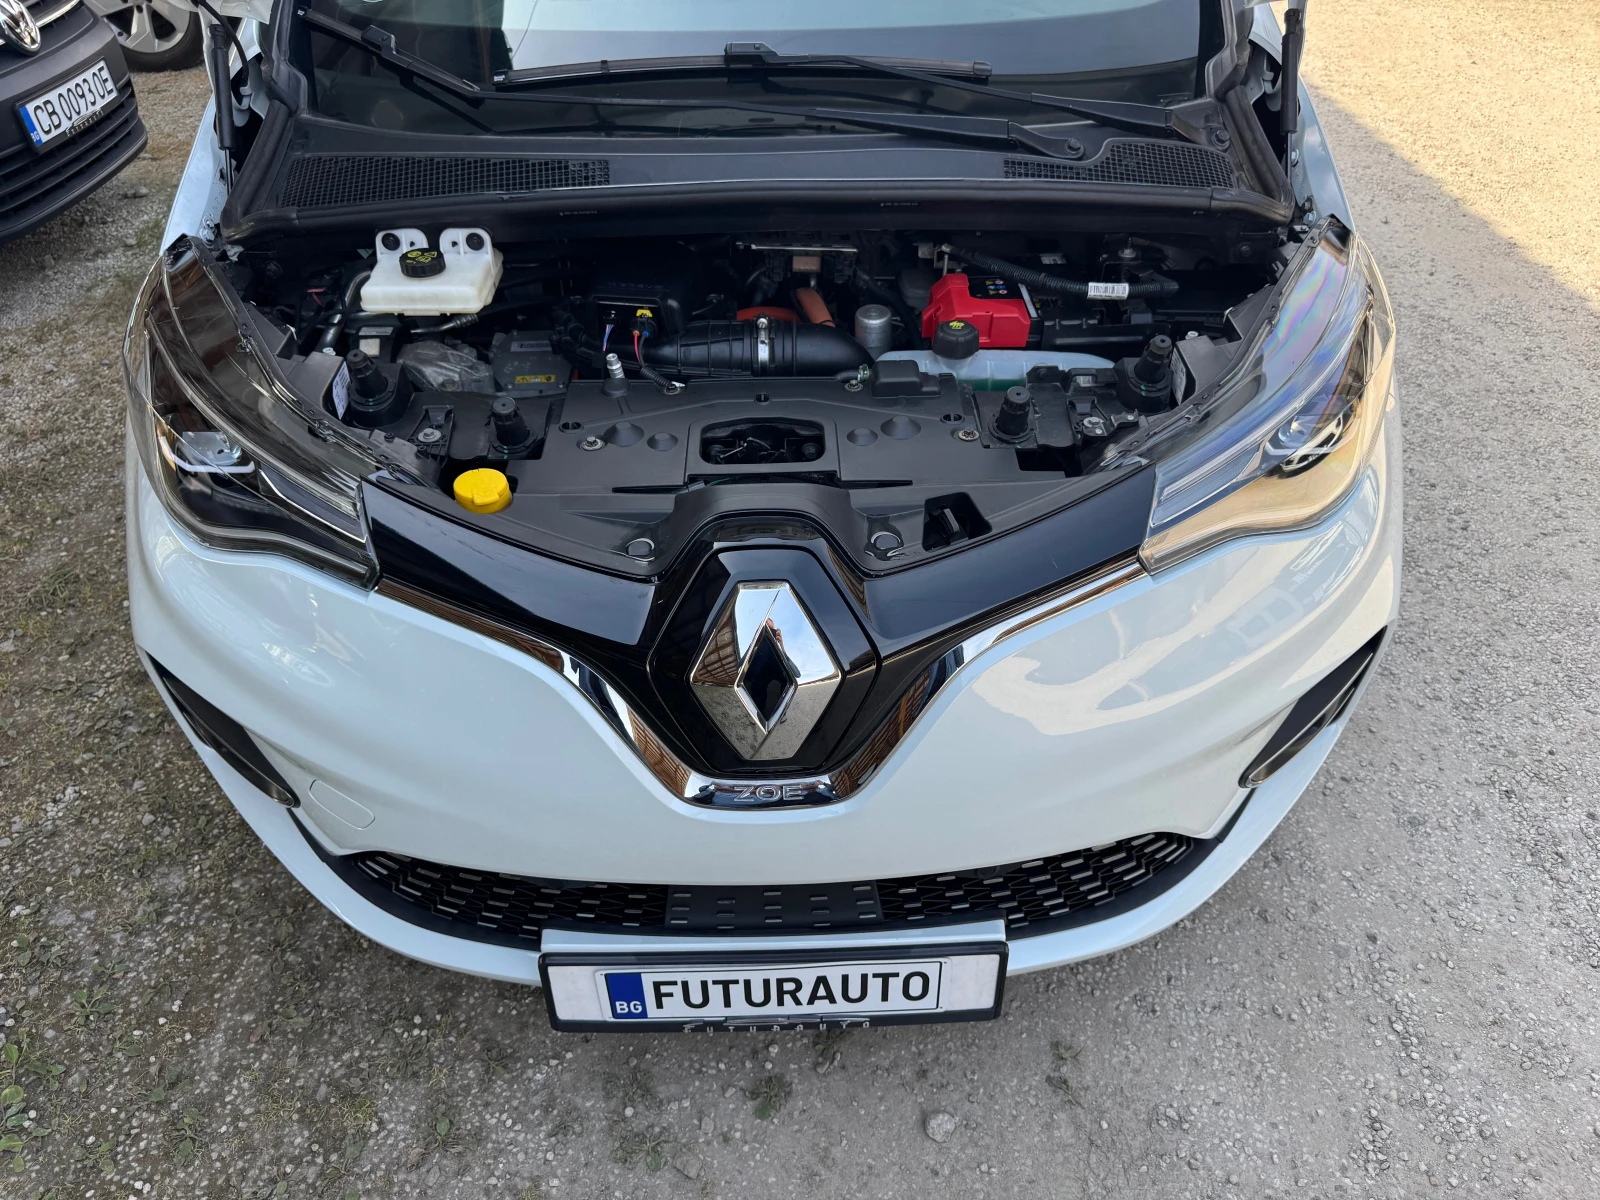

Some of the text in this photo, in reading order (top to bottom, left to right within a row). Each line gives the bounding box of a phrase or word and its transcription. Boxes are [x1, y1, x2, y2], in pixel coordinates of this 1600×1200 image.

[733, 784, 805, 802] ZOE
[651, 970, 931, 1010] FUTURAUTO
[615, 1000, 643, 1014] BG
